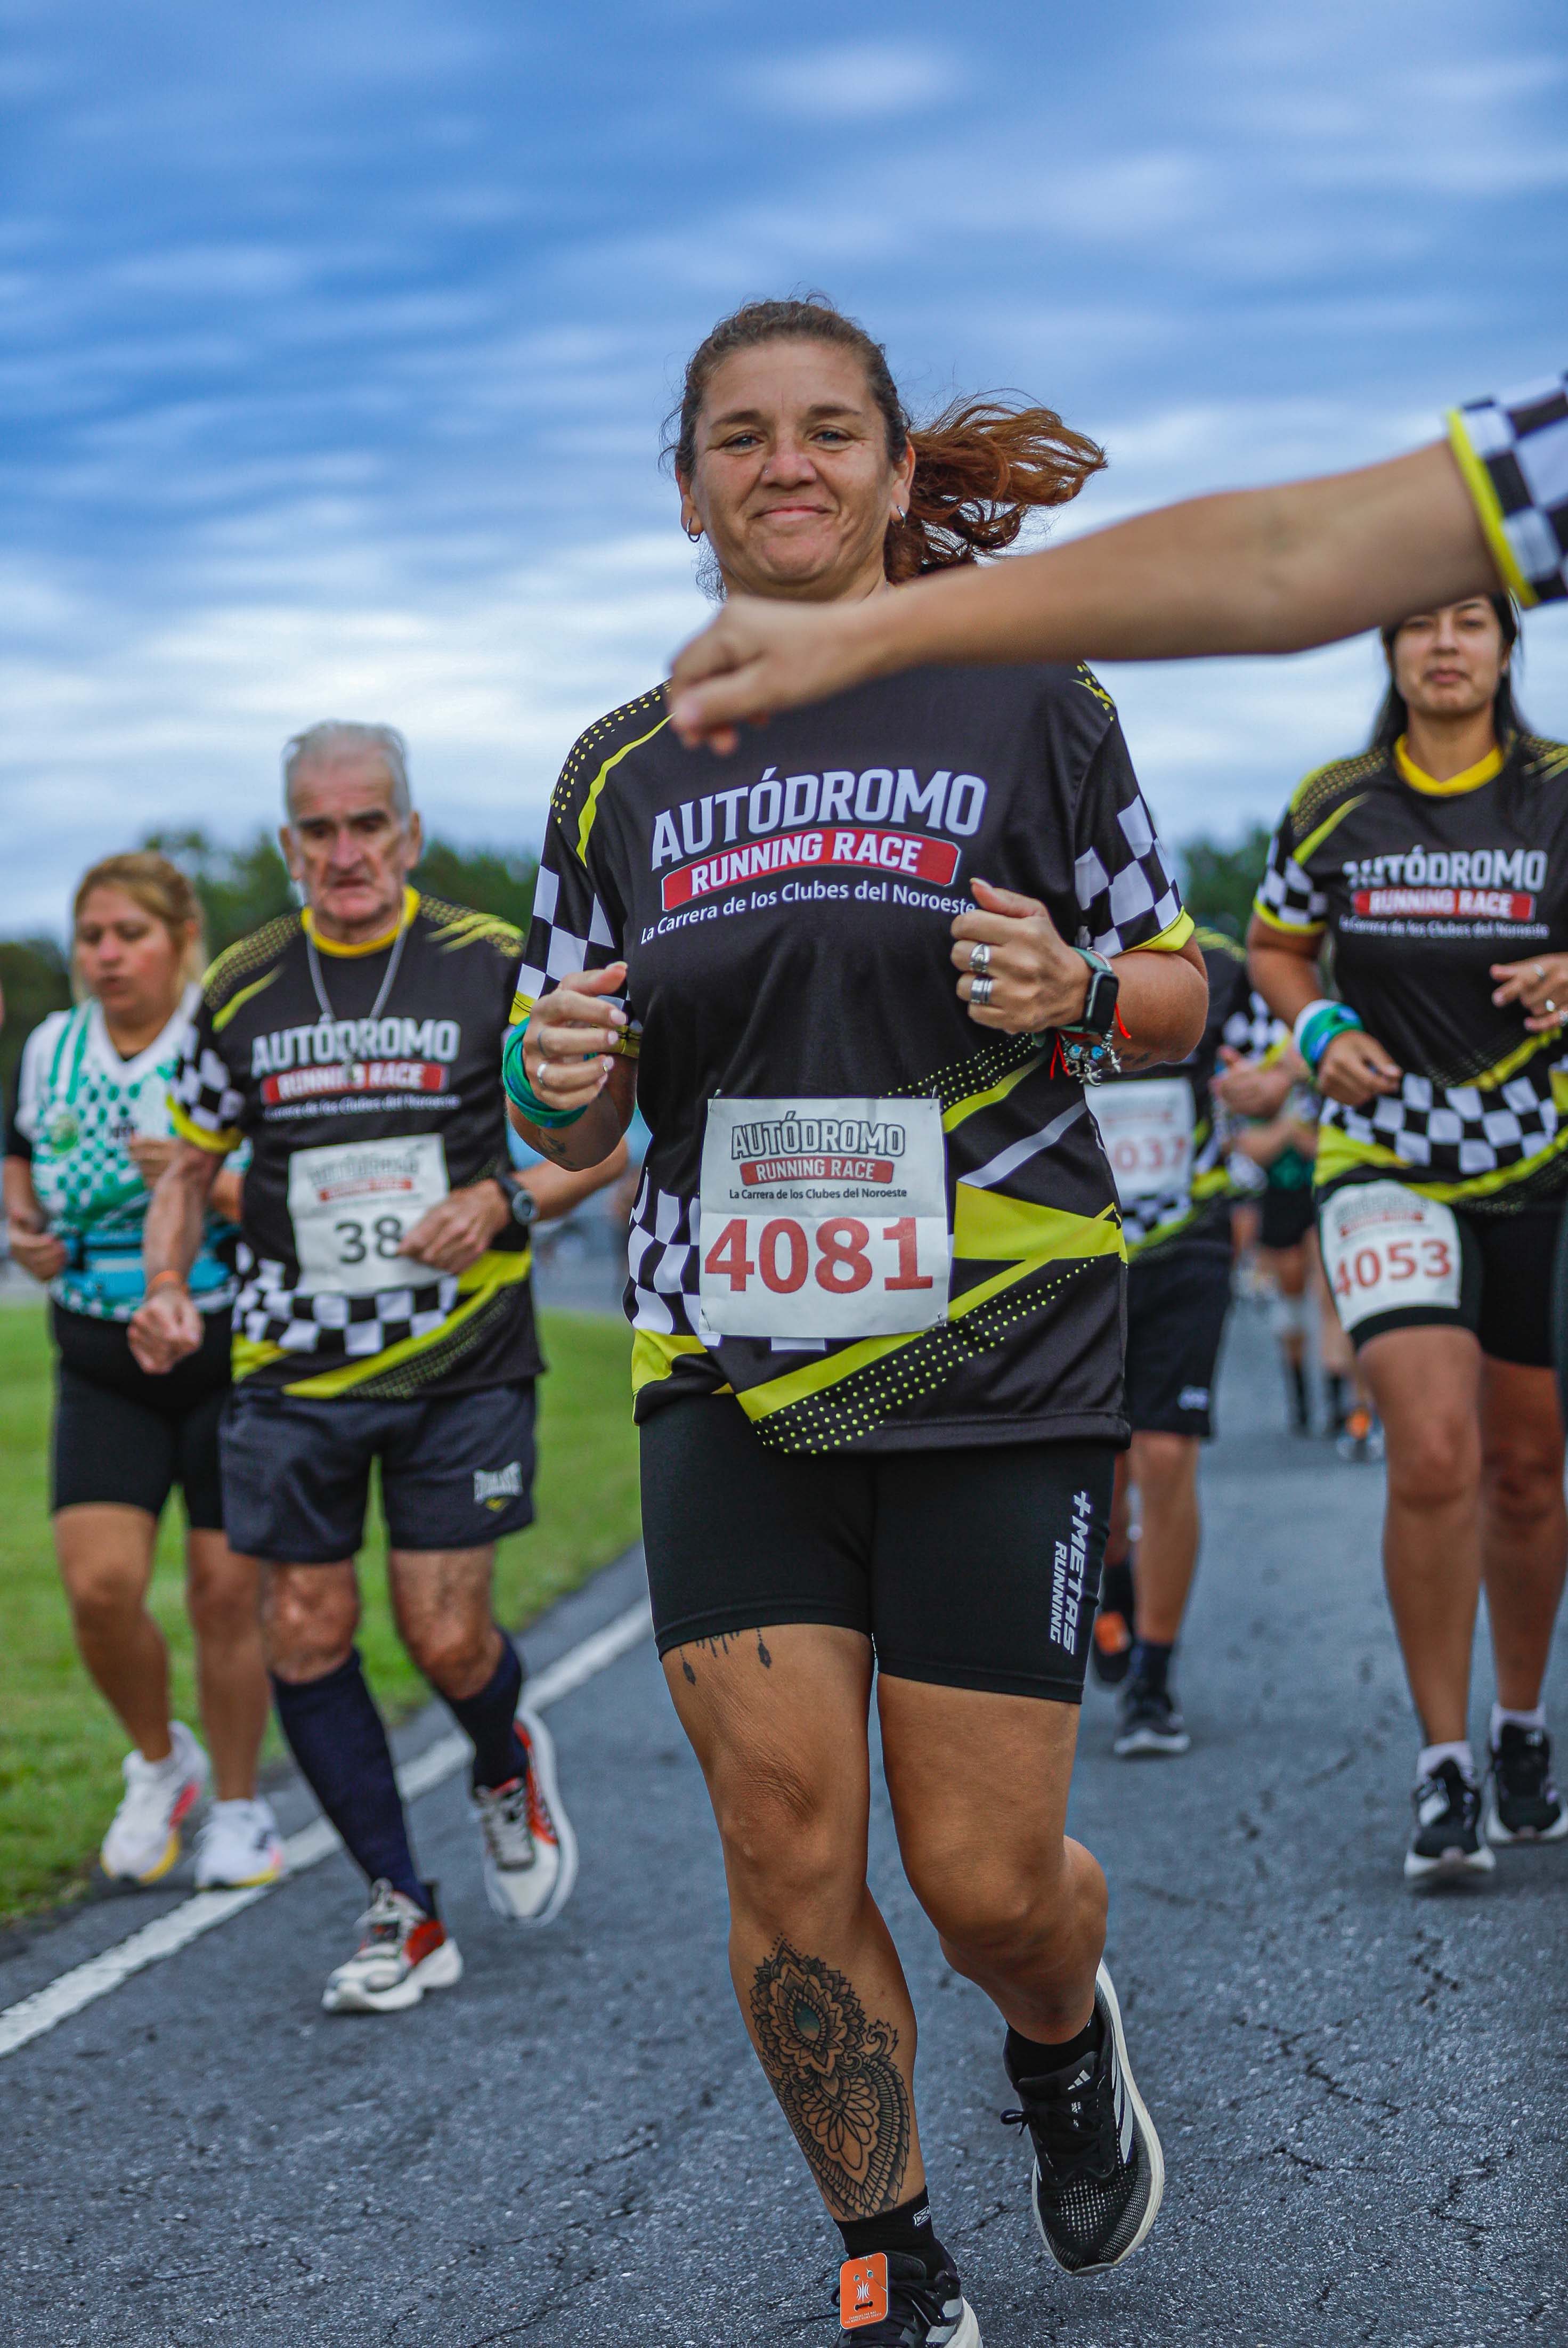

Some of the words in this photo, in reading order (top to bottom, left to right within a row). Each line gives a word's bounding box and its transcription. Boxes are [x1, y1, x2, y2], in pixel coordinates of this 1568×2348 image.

[651, 767, 988, 871] AUTÓDROMO
[691, 832, 823, 896] RUNNING
[831, 832, 923, 874] RACE
[640, 928, 655, 945] La
[657, 906, 718, 935] Carrera
[722, 897, 746, 916] de
[751, 891, 777, 909] los
[781, 880, 849, 901] Clubes
[854, 880, 887, 901] del
[892, 883, 976, 916] Noroeste
[1458, 890, 1513, 919] RACE
[730, 1110, 905, 1160] AUTÓDROMO
[729, 1189, 740, 1199] La
[741, 1189, 774, 1199] Carrera
[776, 1189, 787, 1199] de
[790, 1189, 803, 1199] los
[805, 1189, 840, 1199] Clubes
[843, 1188, 858, 1198] del
[861, 1188, 907, 1198] Noroeste
[755, 1159, 825, 1182] RUNNING
[831, 1160, 875, 1180] RACE
[334, 1215, 403, 1264] 38
[704, 1217, 933, 1294] 4081
[1050, 1541, 1068, 1644] RUNNING
